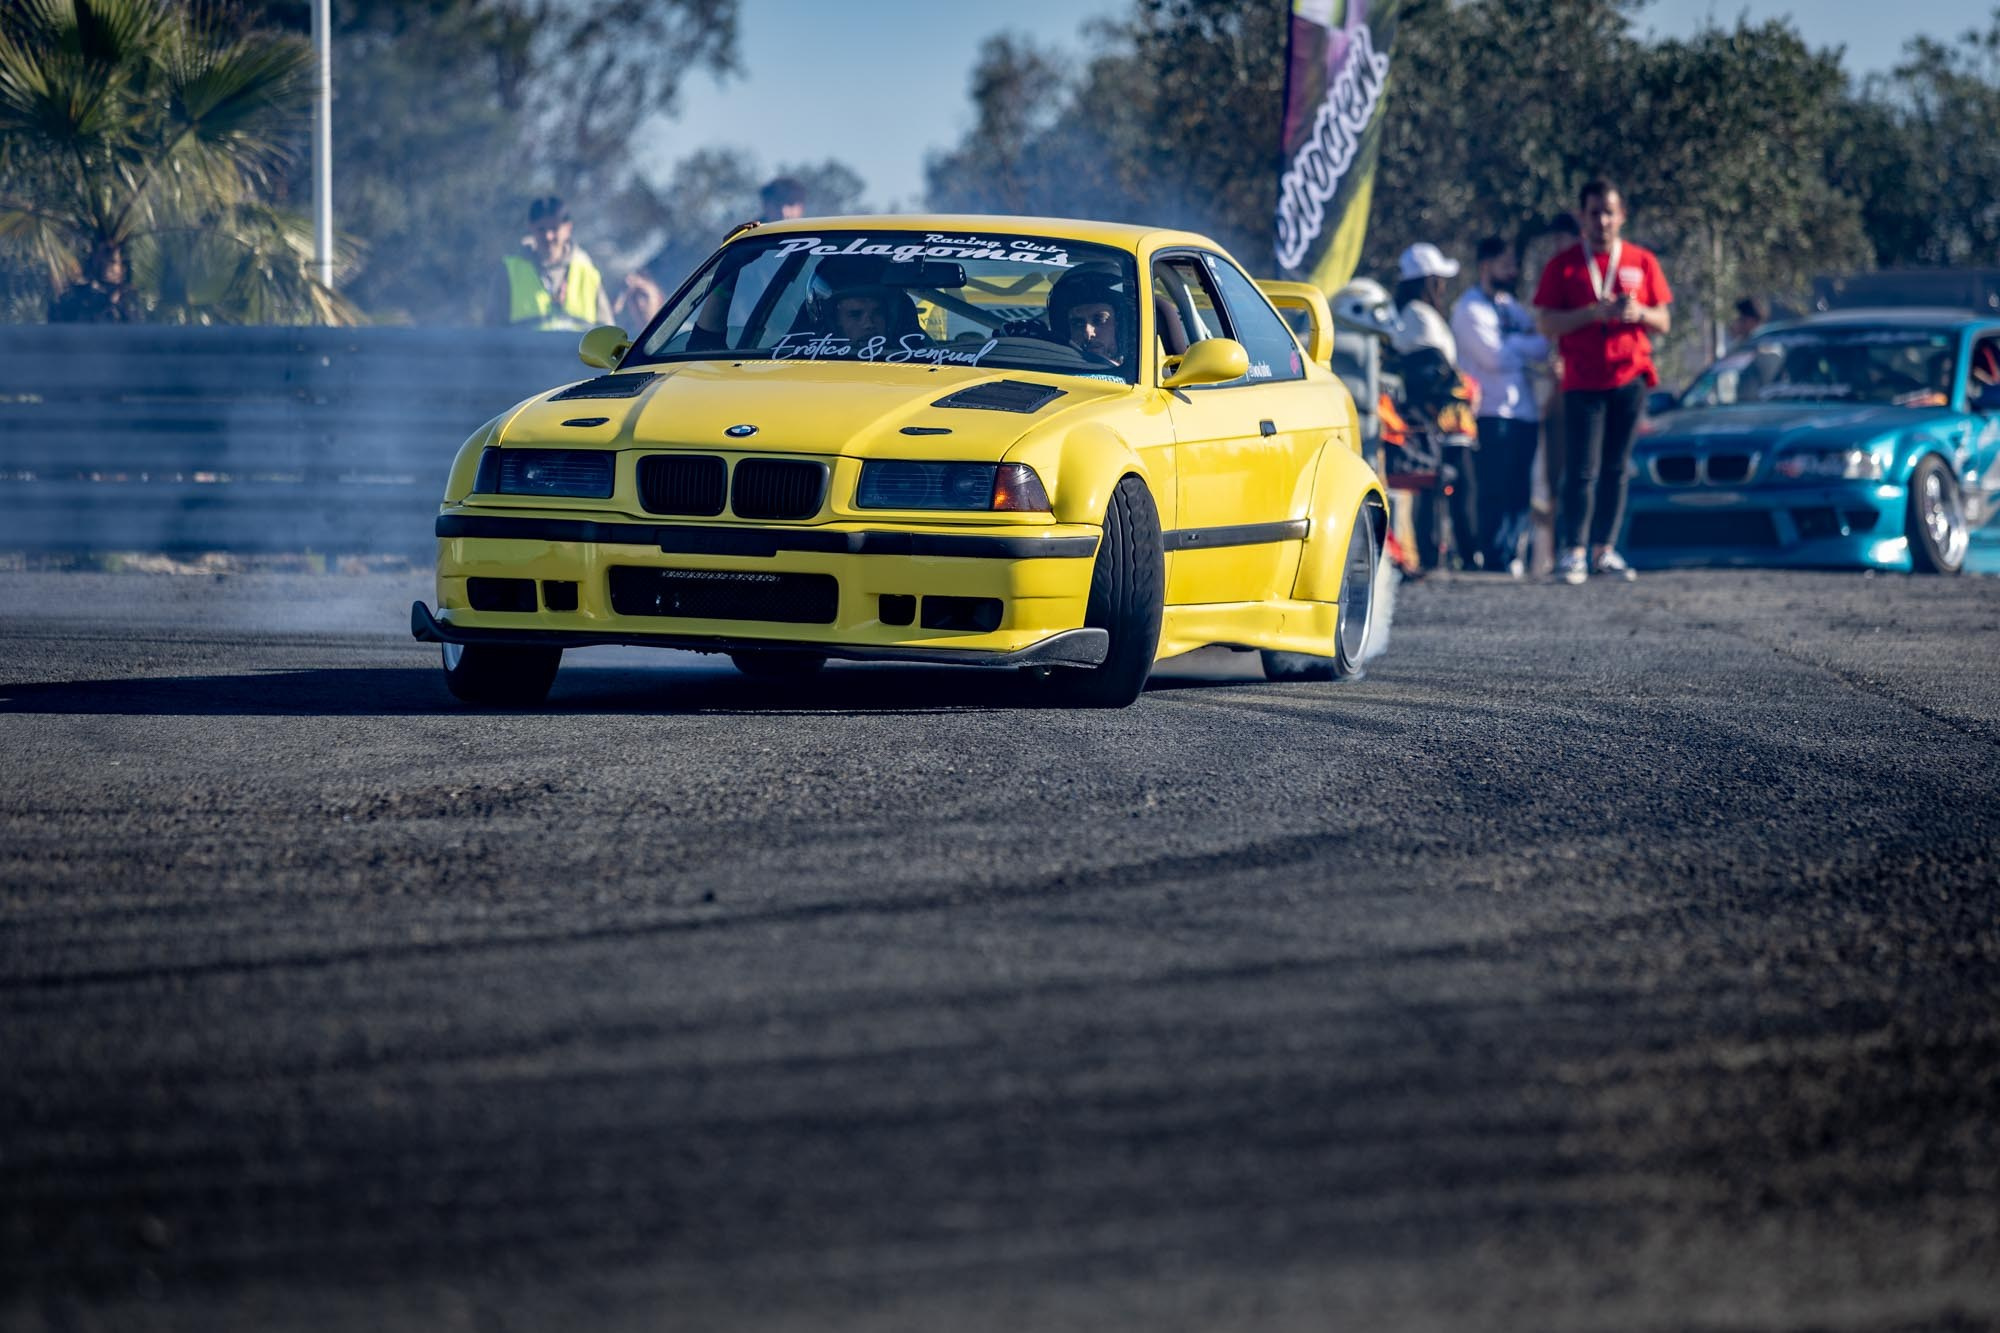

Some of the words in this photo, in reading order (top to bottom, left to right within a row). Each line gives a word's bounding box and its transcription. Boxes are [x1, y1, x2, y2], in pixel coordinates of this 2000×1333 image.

[775, 237, 1075, 267] Pelagomas
[924, 233, 1001, 248] Racing
[1010, 240, 1066, 253] Club
[771, 332, 851, 361] Erótico
[857, 336, 886, 362] &
[885, 334, 998, 367] Sensual
